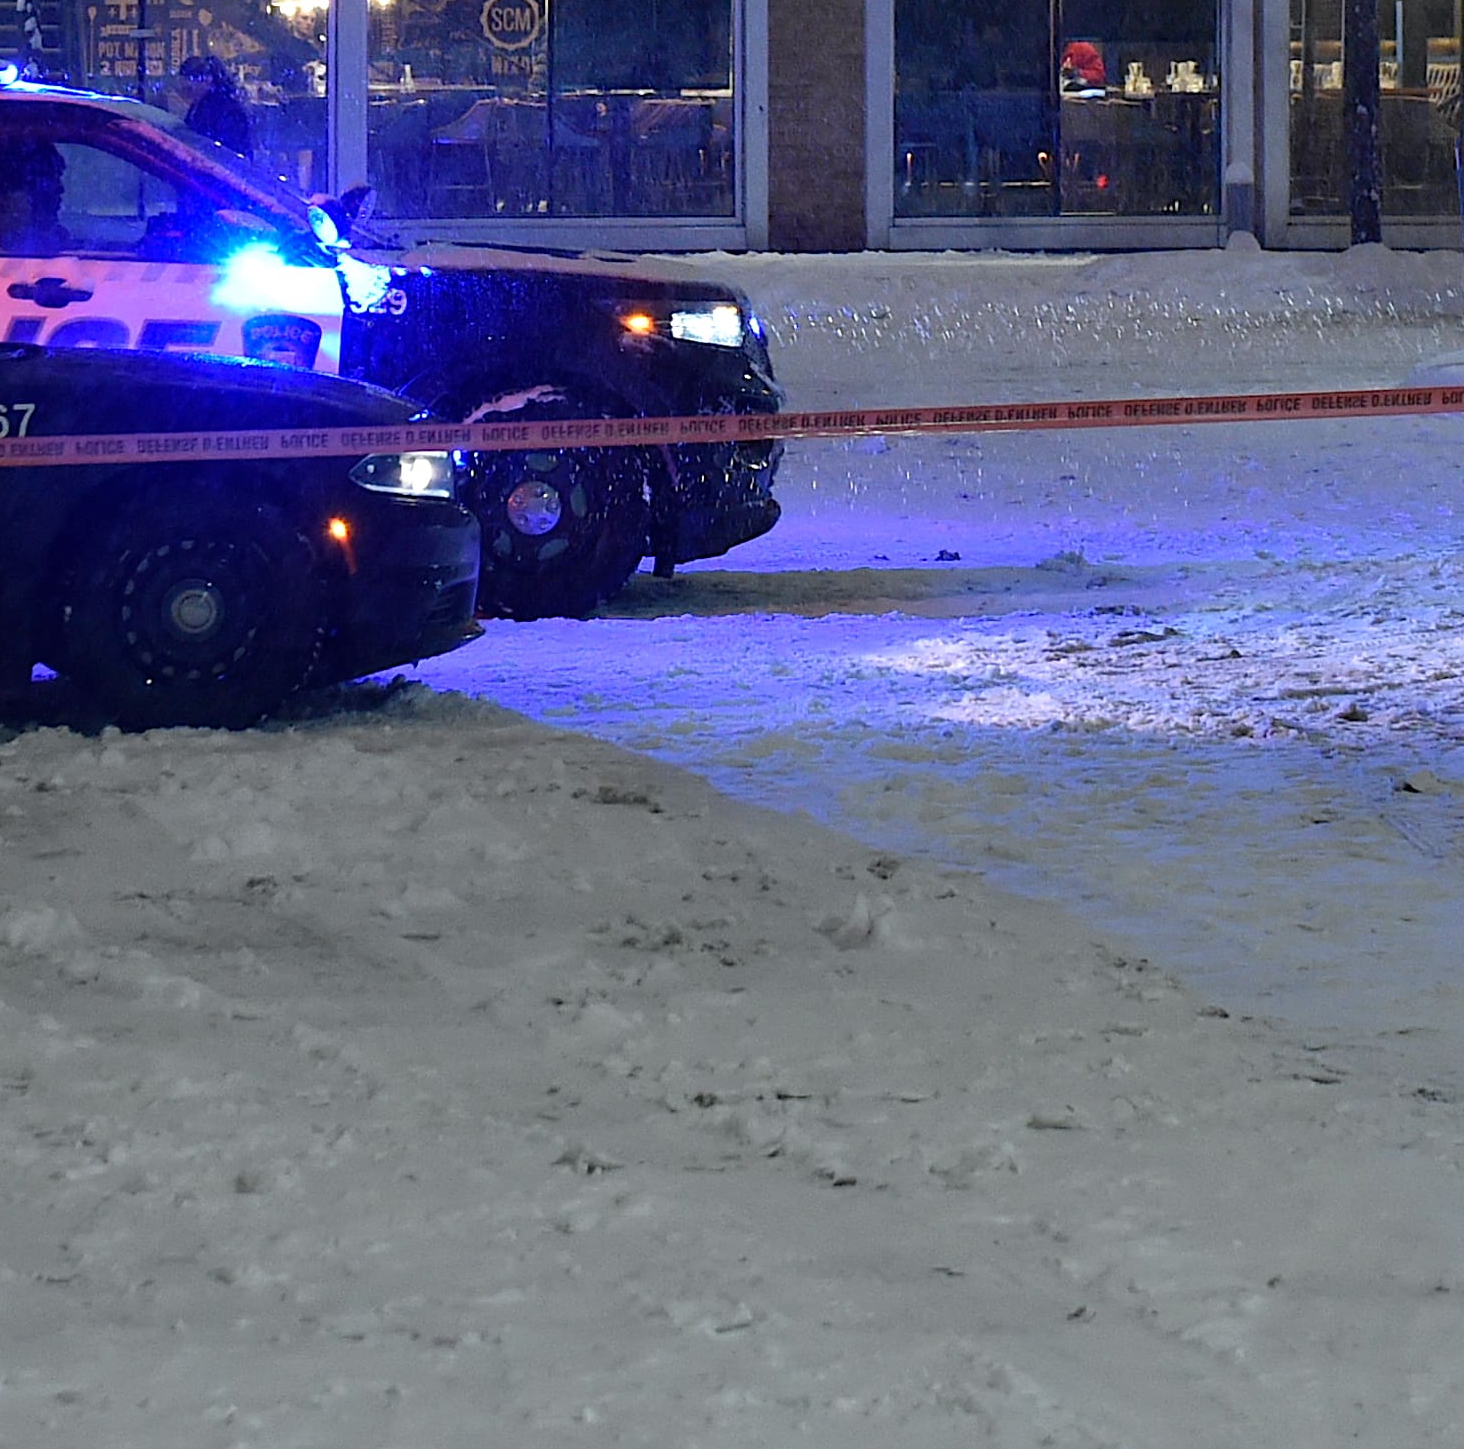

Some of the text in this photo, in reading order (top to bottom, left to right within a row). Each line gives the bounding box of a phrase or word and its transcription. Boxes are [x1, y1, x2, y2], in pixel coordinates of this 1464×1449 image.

[491, 7, 531, 31] SCM
[350, 288, 407, 315] 29
[250, 325, 314, 343] POLICE
